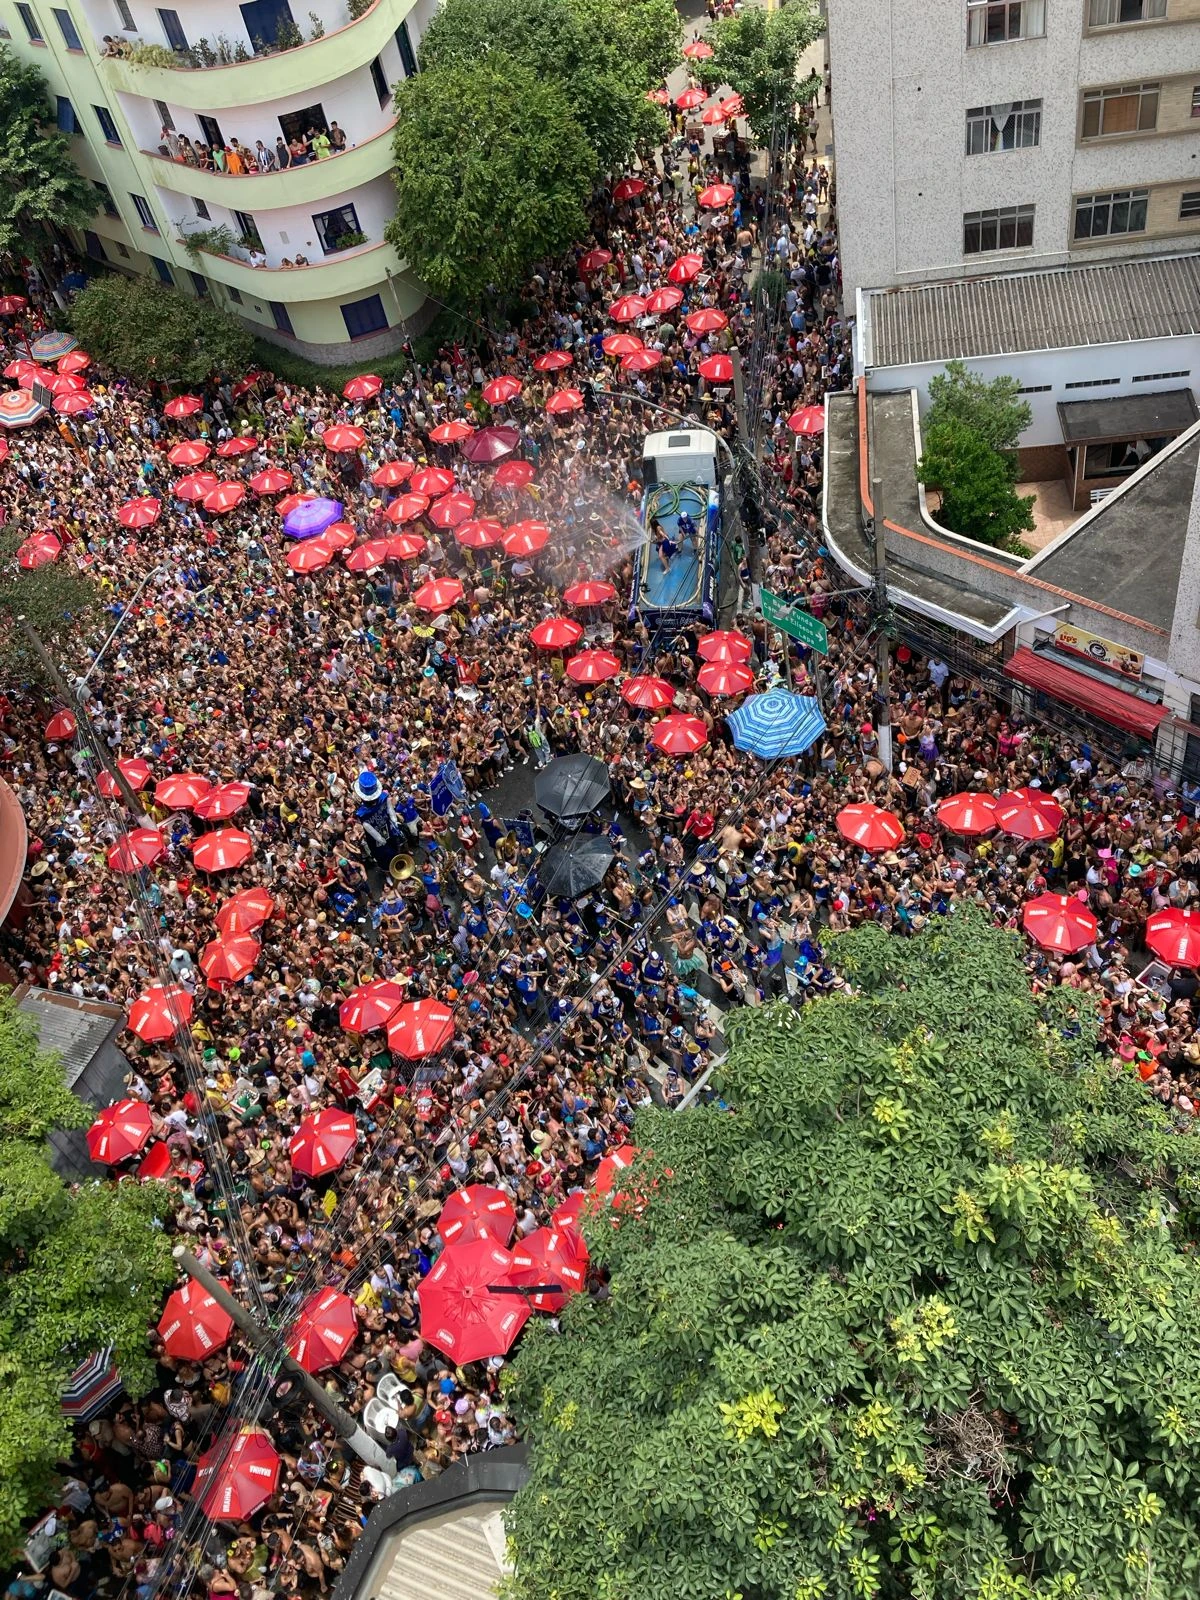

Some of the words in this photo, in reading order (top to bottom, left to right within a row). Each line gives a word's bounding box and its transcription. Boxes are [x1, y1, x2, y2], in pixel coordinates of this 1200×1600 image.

[799, 631, 815, 645] Lapa
[194, 1323, 212, 1349] BRAHMA
[249, 1464, 271, 1477] BRAHMA
[222, 1482, 233, 1513] BRAHMA
